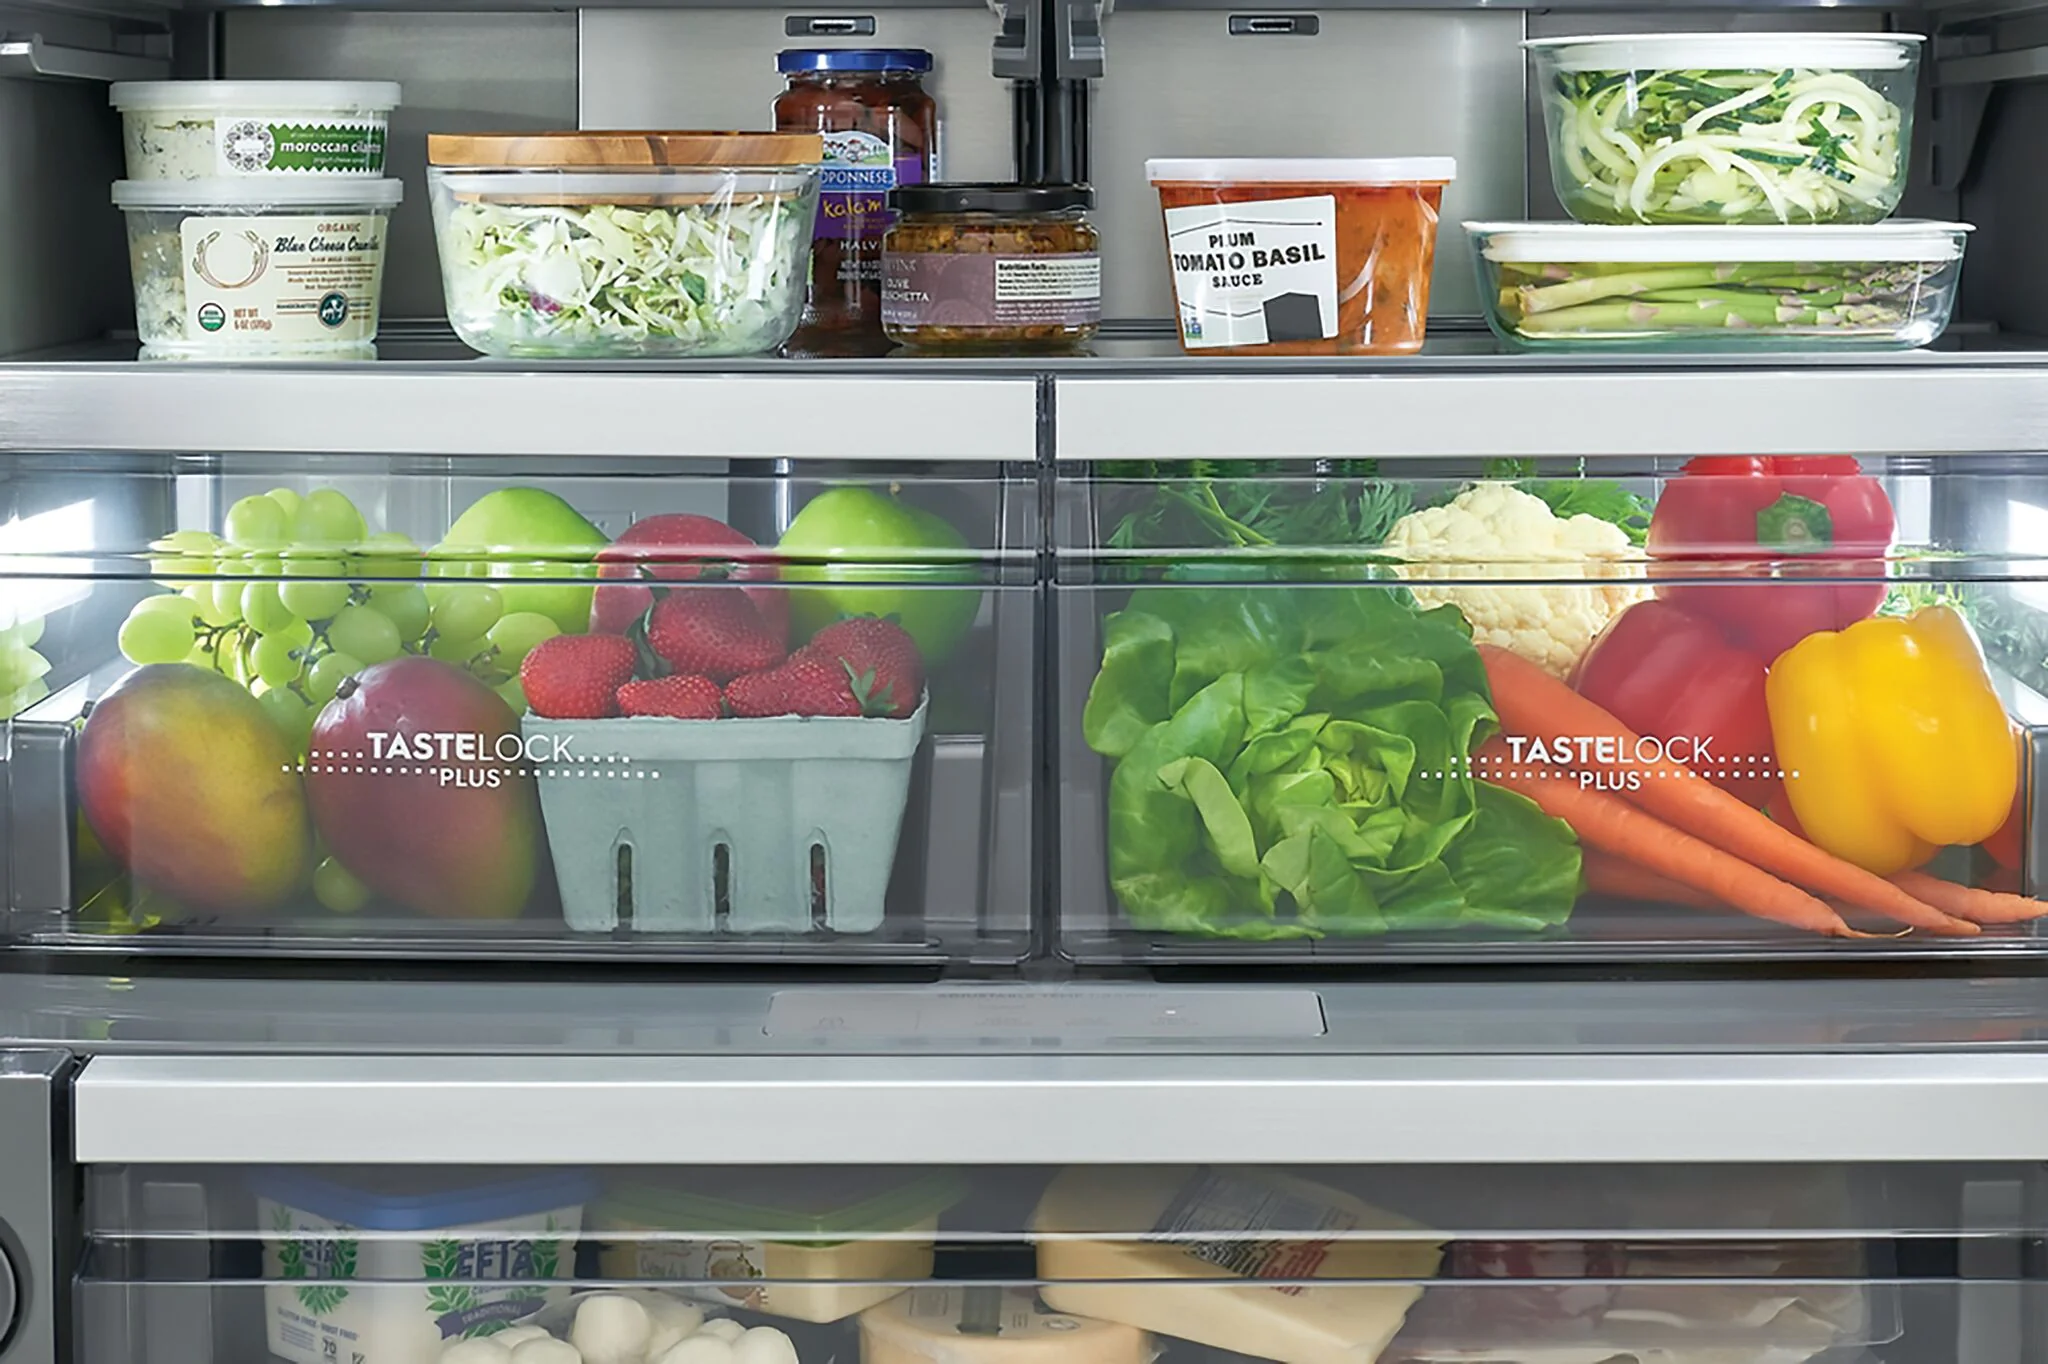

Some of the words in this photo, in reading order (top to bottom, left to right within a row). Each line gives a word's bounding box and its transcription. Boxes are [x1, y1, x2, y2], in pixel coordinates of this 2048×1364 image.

[280, 141, 349, 153] moroccan
[317, 222, 361, 232] ORGANIC
[274, 235, 306, 252] Blue
[308, 236, 345, 252] Cheese
[840, 241, 881, 250] HALV
[1208, 232, 1255, 248] PLUM
[1174, 251, 1245, 272] TOMATO
[1252, 243, 1325, 268] BASIL
[1212, 274, 1264, 288] SAUCE
[367, 732, 574, 762] TASTELOCK
[1506, 736, 1714, 764] TASTELOCK
[440, 768, 501, 788] PLUS
[1580, 771, 1641, 790] PLUS
